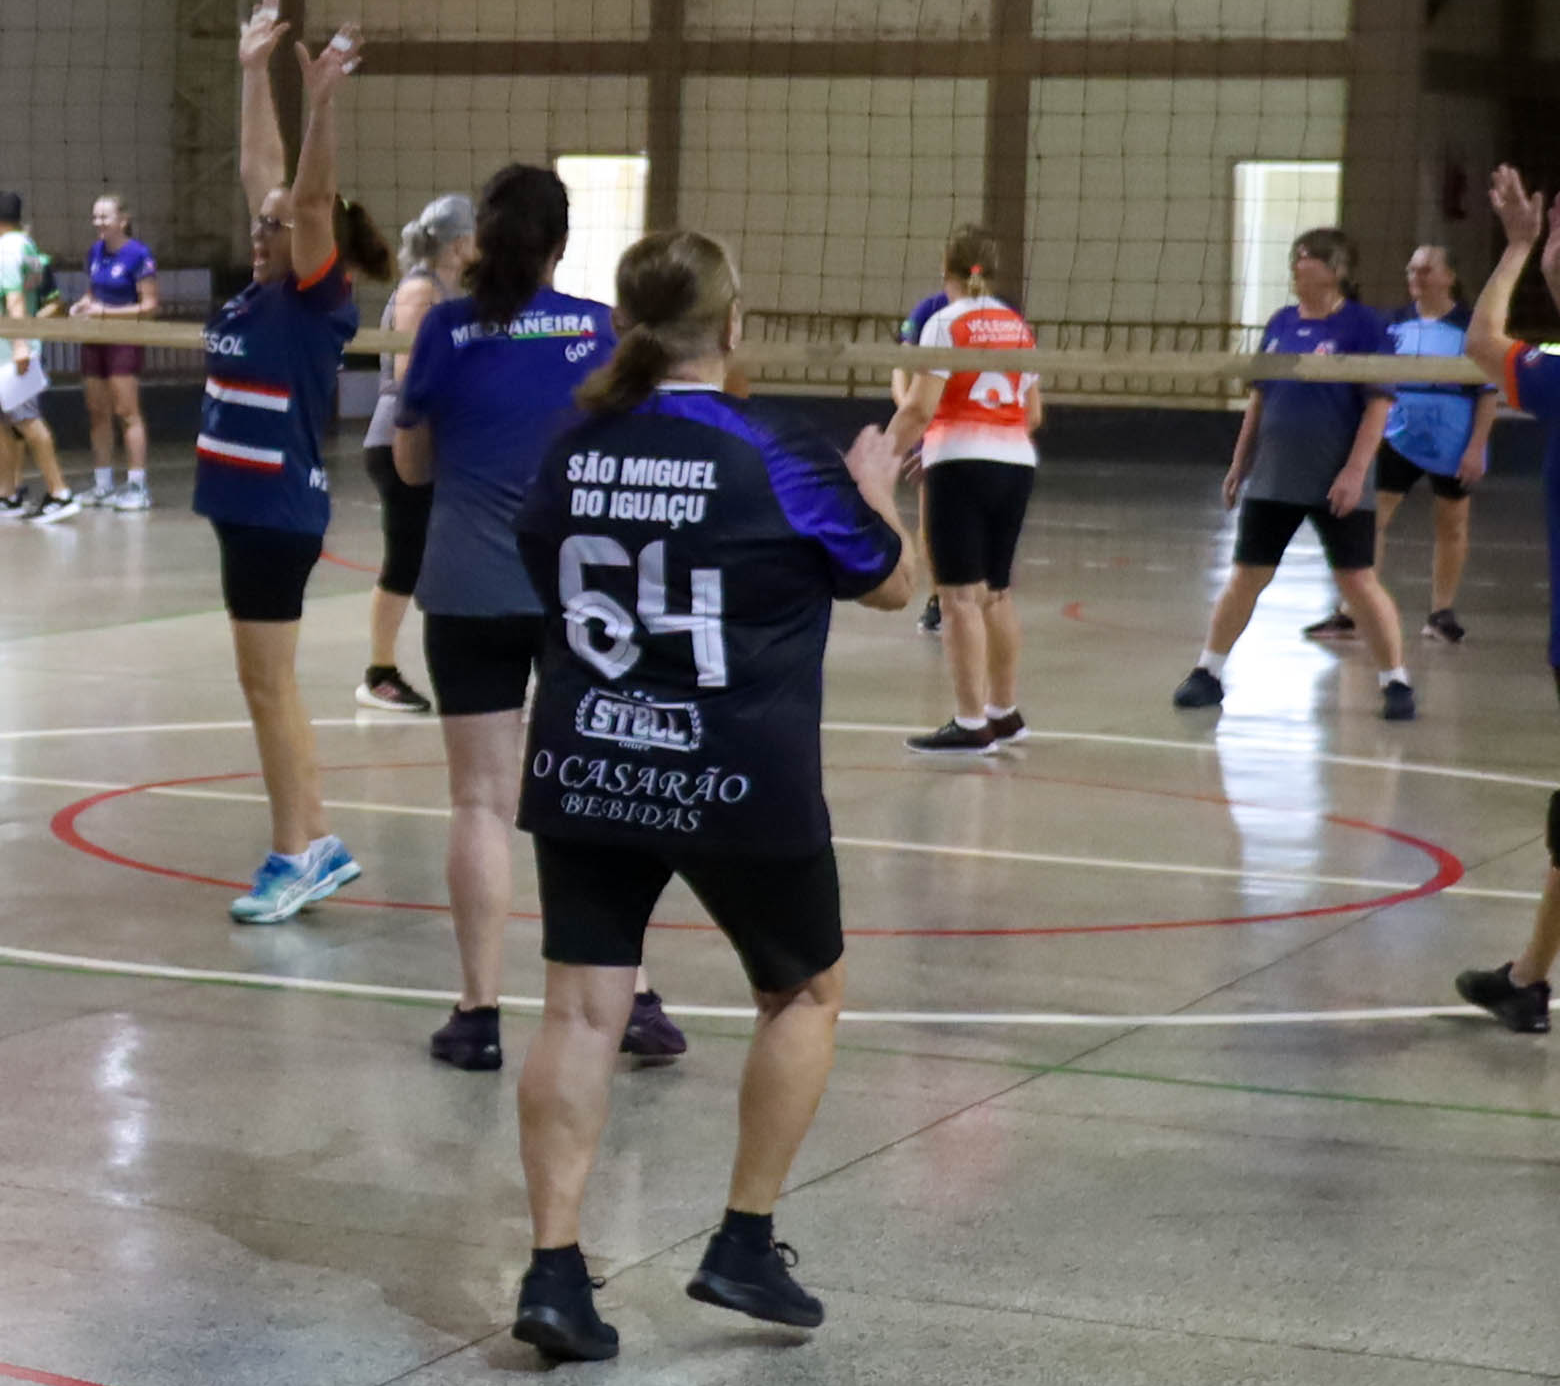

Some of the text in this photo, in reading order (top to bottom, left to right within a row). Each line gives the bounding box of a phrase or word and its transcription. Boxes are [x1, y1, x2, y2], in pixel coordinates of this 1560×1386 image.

[567, 451, 718, 490] SÃO MIGUEL
[571, 488, 706, 530] DO IGUAÇU
[558, 534, 728, 687] 64
[532, 749, 752, 806] O CASARÃO
[561, 792, 702, 833] BEBIDAS
